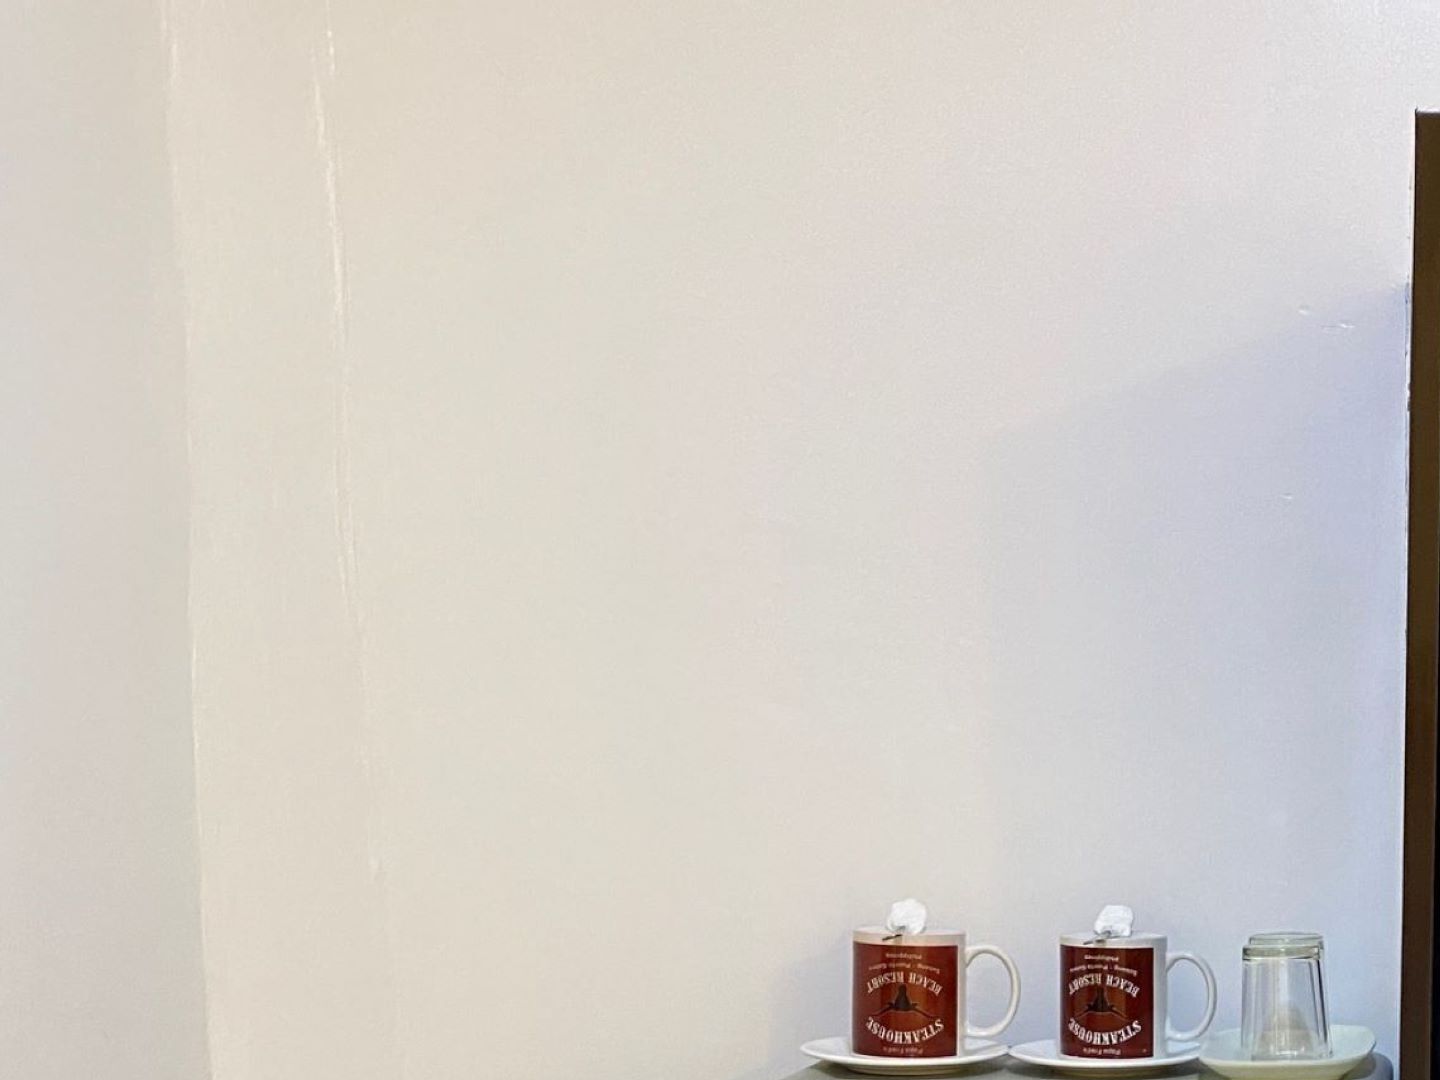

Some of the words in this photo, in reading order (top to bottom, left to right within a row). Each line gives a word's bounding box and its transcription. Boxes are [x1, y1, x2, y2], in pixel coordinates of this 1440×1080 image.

[866, 971, 905, 994] RESORT
[908, 972, 943, 996] BEACH
[1068, 973, 1102, 996] RESORT
[1106, 973, 1140, 998] BEACH
[865, 1016, 945, 1045] STEAKHOUSE
[1068, 1018, 1142, 1046] STEAKHOUSE
